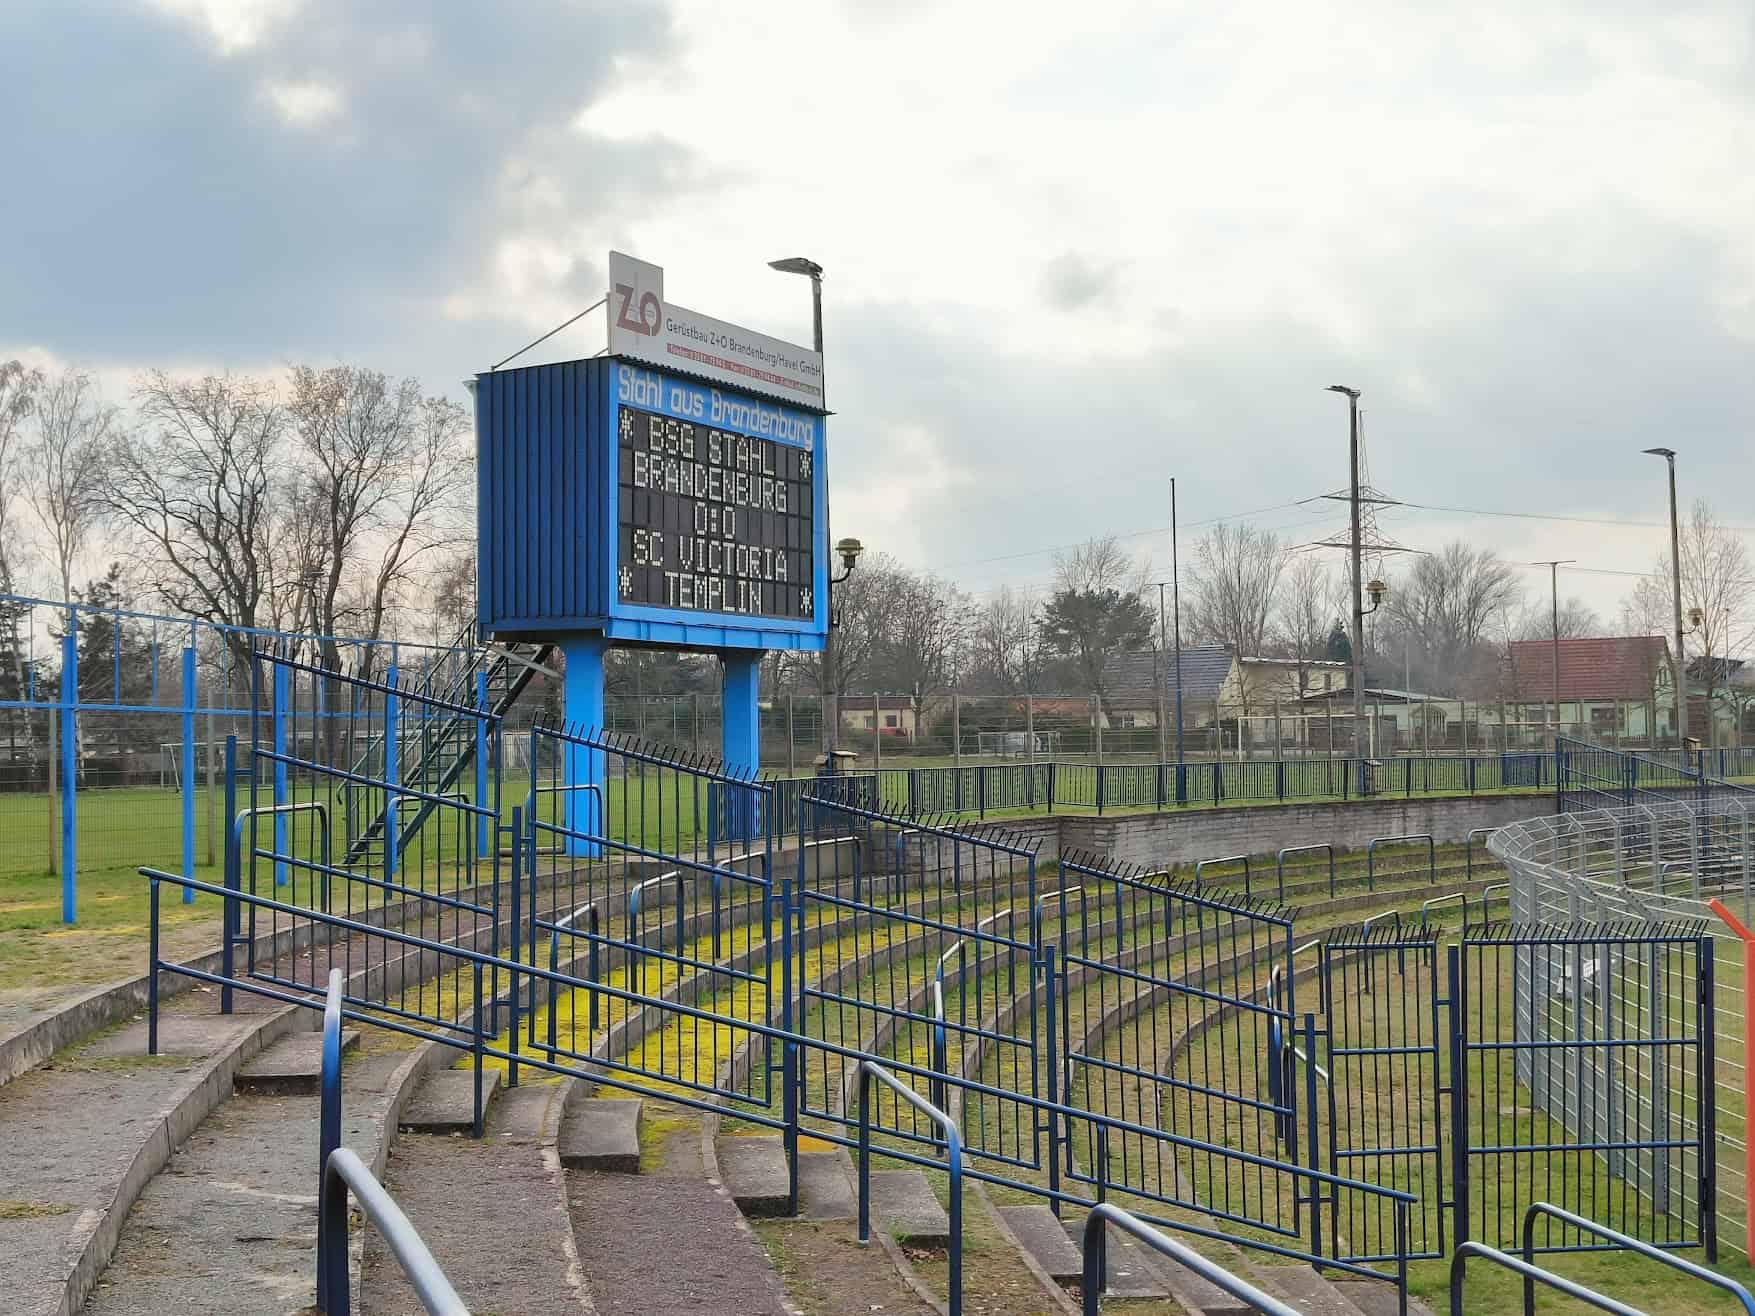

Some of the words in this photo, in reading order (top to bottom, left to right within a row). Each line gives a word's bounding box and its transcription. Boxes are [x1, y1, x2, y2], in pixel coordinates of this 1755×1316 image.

[666, 319, 708, 343] Gerüstbau
[710, 331, 727, 349] Z+O
[729, 337, 799, 371] Brandenburg/Havel
[800, 360, 822, 377] GmbH
[618, 365, 662, 408] Stahl
[671, 387, 704, 417] aus
[712, 388, 814, 451] Brandenburg
[649, 416, 694, 458] BSG
[709, 431, 775, 475] STAHL
[635, 452, 787, 513] BRANDENBURG
[695, 502, 735, 539] 0:0
[634, 529, 663, 566] SC
[679, 536, 787, 582] VICTORIA
[665, 571, 762, 614] TEMPLIN
